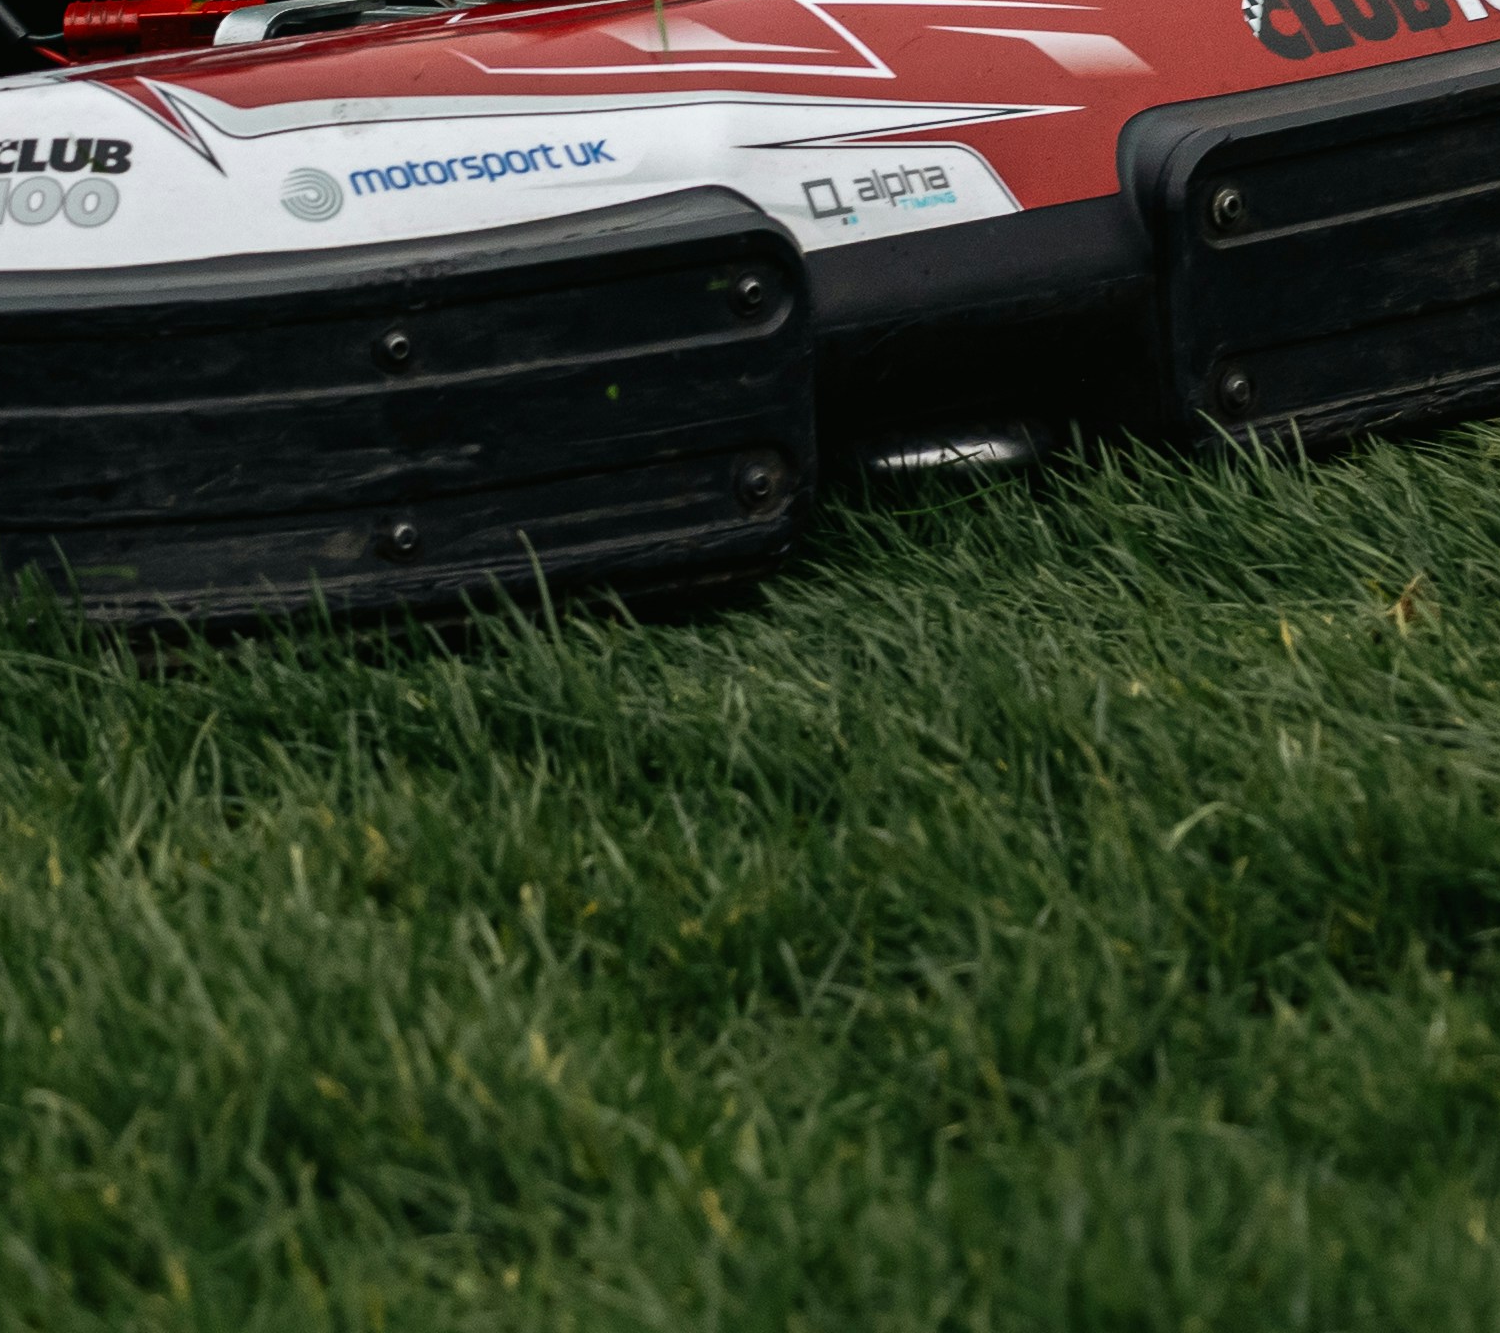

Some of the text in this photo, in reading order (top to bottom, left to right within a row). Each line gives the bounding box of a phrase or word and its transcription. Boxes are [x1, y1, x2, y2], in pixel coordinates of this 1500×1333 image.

[350, 138, 617, 196] motorsport UK
[852, 164, 951, 208] alpha
